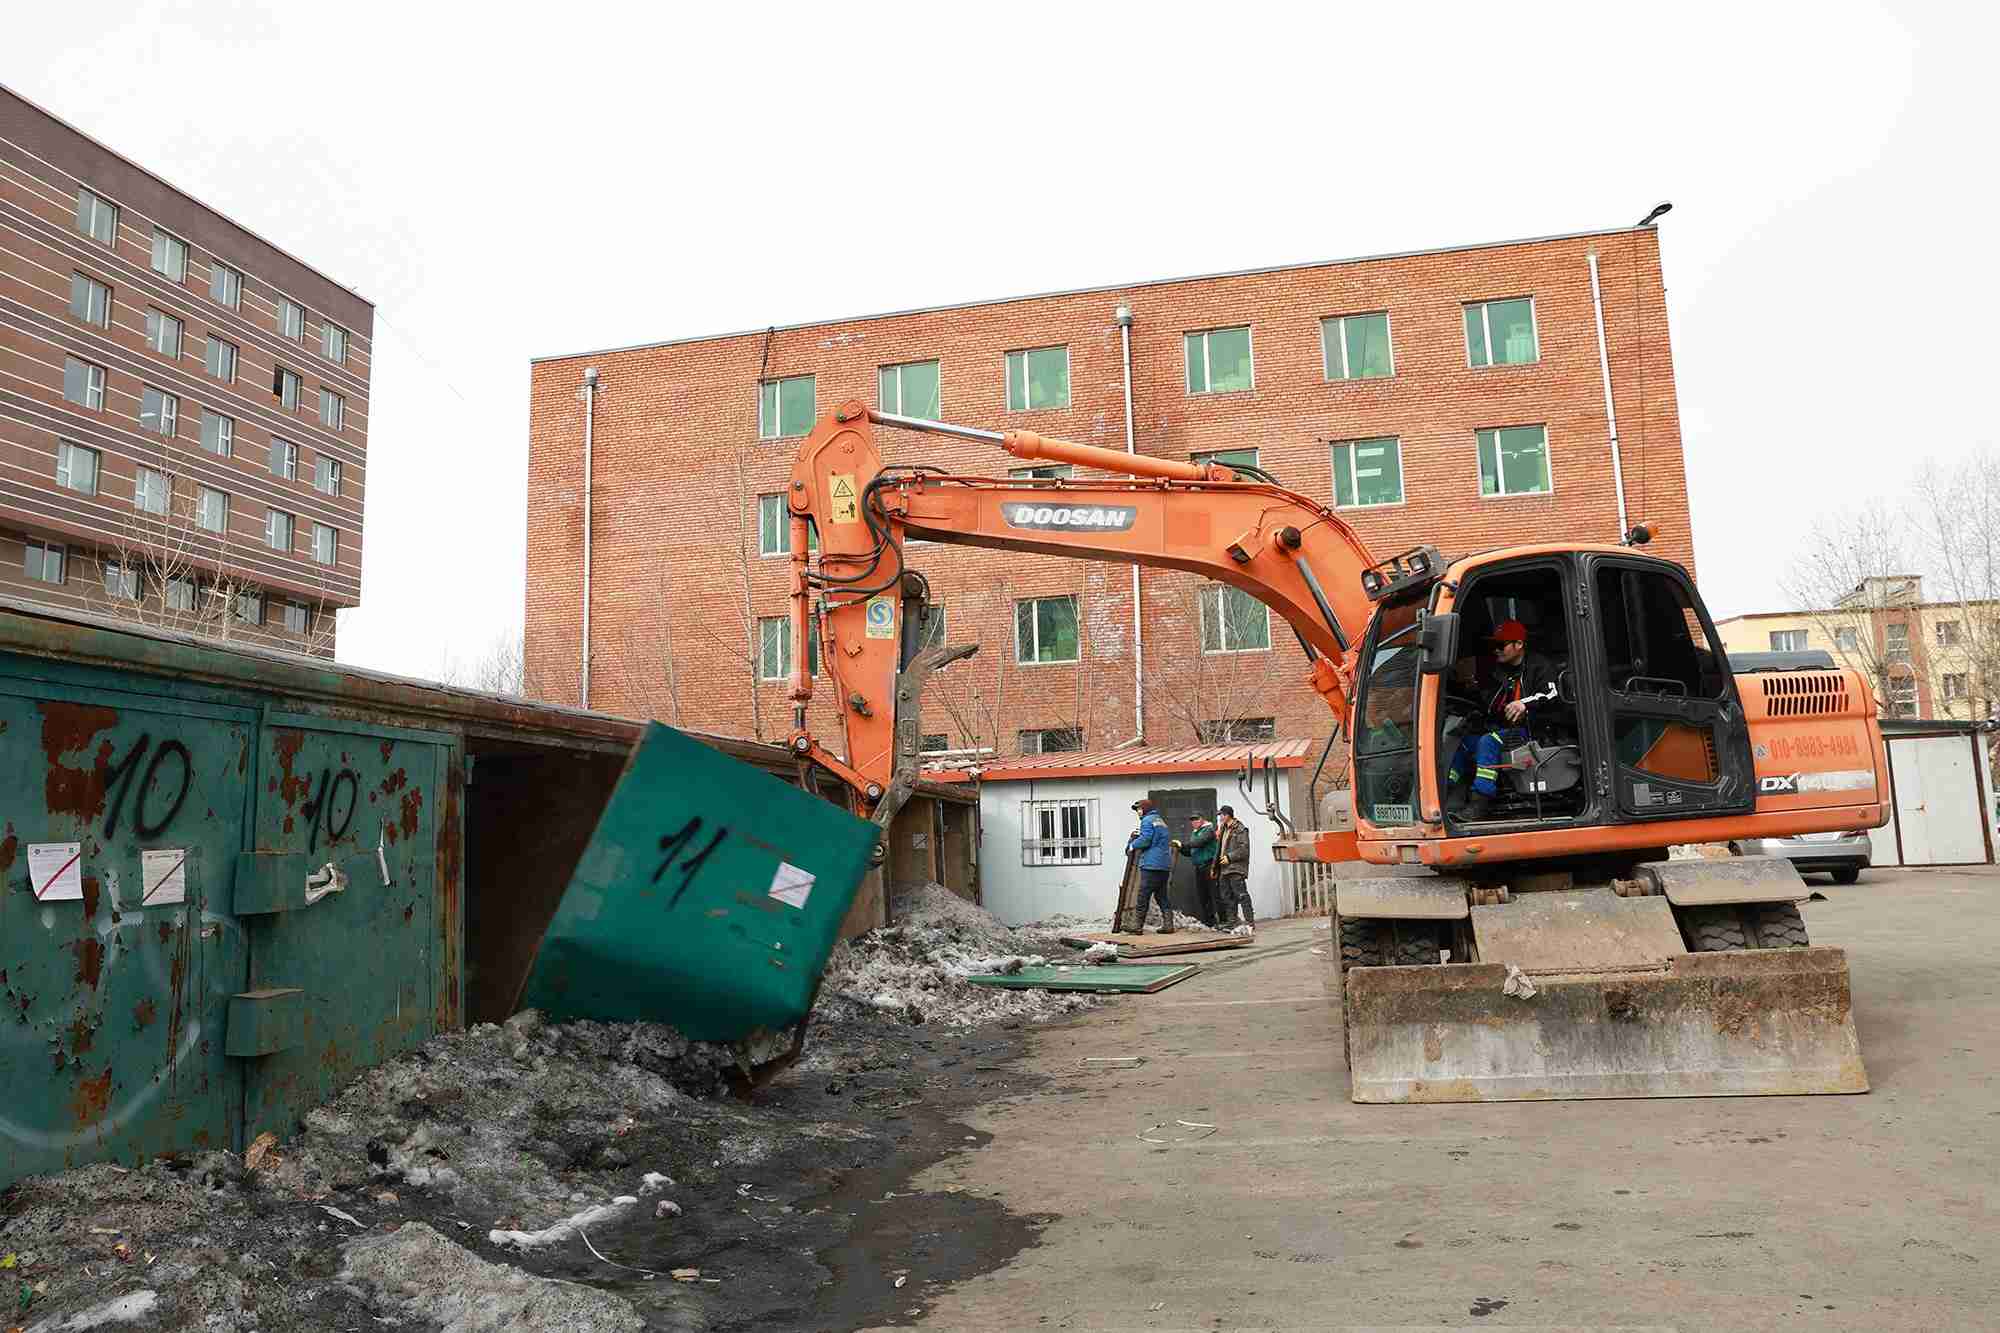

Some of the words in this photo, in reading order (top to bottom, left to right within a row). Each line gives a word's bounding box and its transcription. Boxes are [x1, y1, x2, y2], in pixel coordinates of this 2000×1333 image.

[1014, 506, 1127, 527] DOOSAN
[103, 731, 192, 841] 10
[303, 766, 359, 855] 10
[1760, 771, 1801, 791] DX
[651, 815, 731, 911] 11
